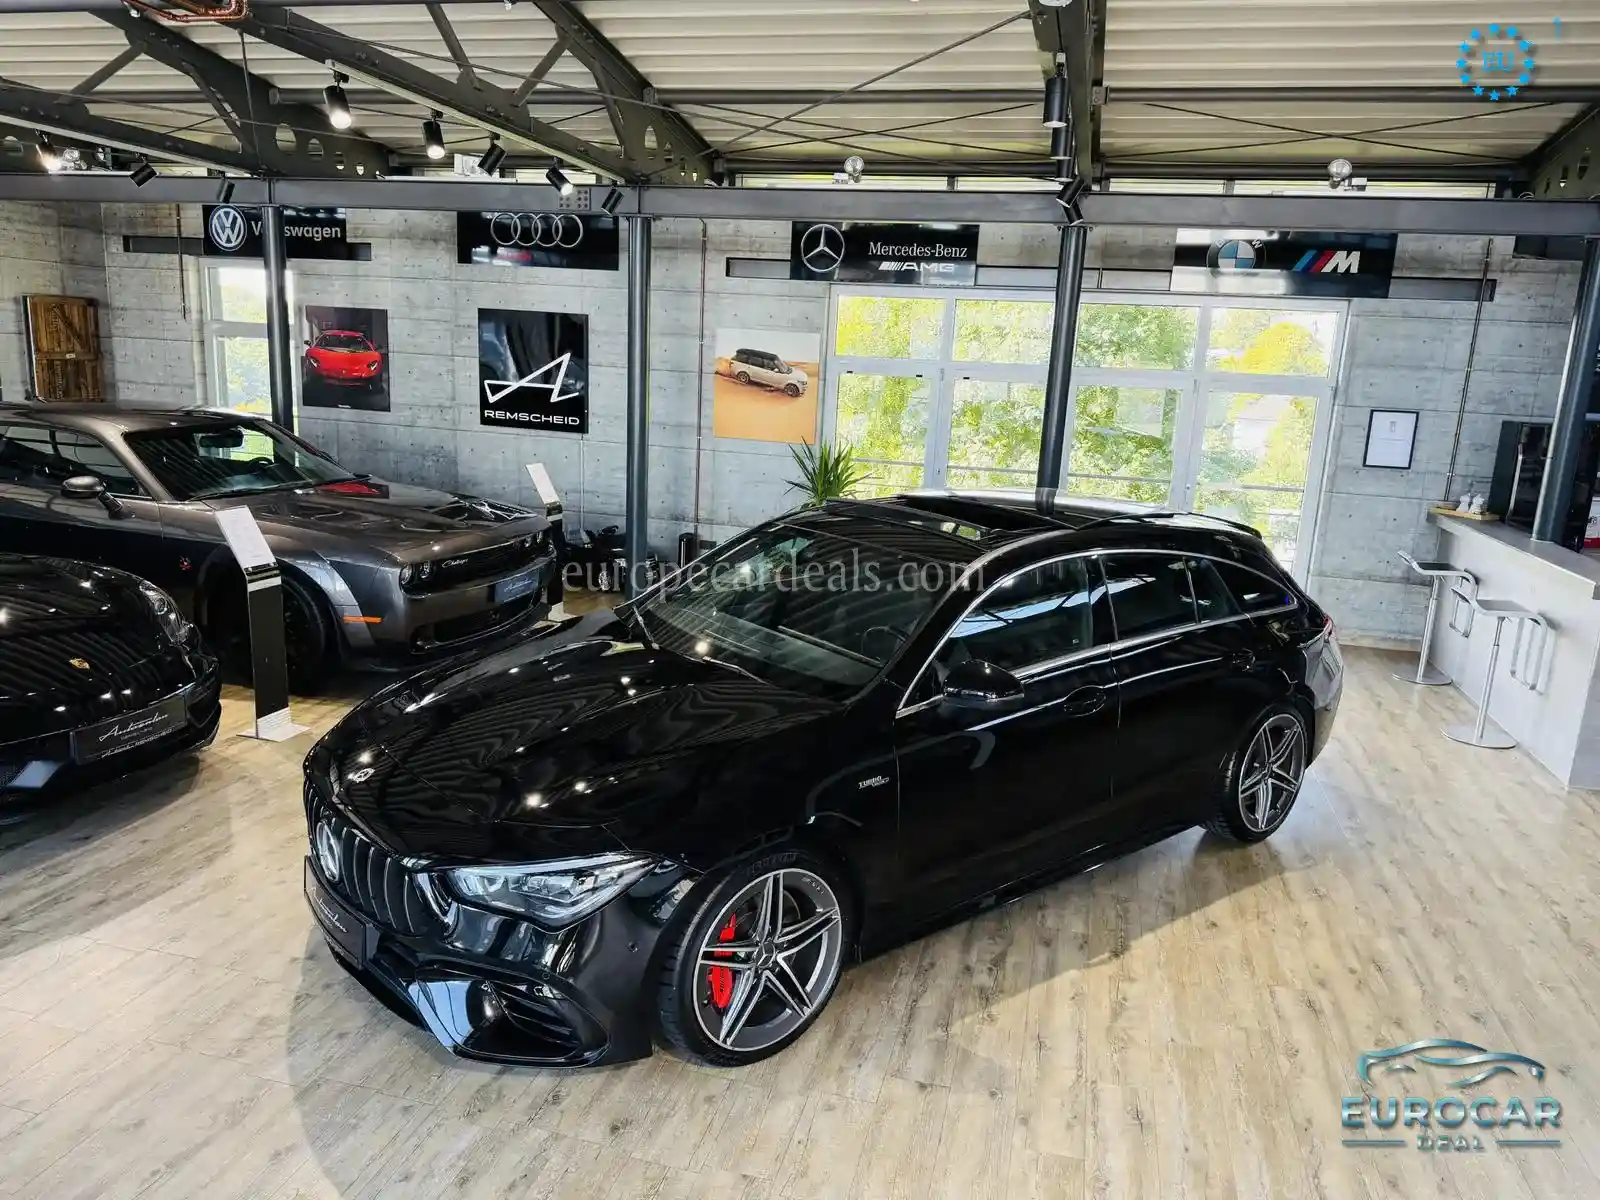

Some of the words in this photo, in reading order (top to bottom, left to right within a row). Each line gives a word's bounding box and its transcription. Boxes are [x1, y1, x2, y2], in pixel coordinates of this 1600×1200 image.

[251, 220, 341, 241] Vswagen
[868, 242, 968, 258] Mercedes-Benz
[900, 261, 955, 273] AMG
[484, 409, 580, 425] REMSCHEID
